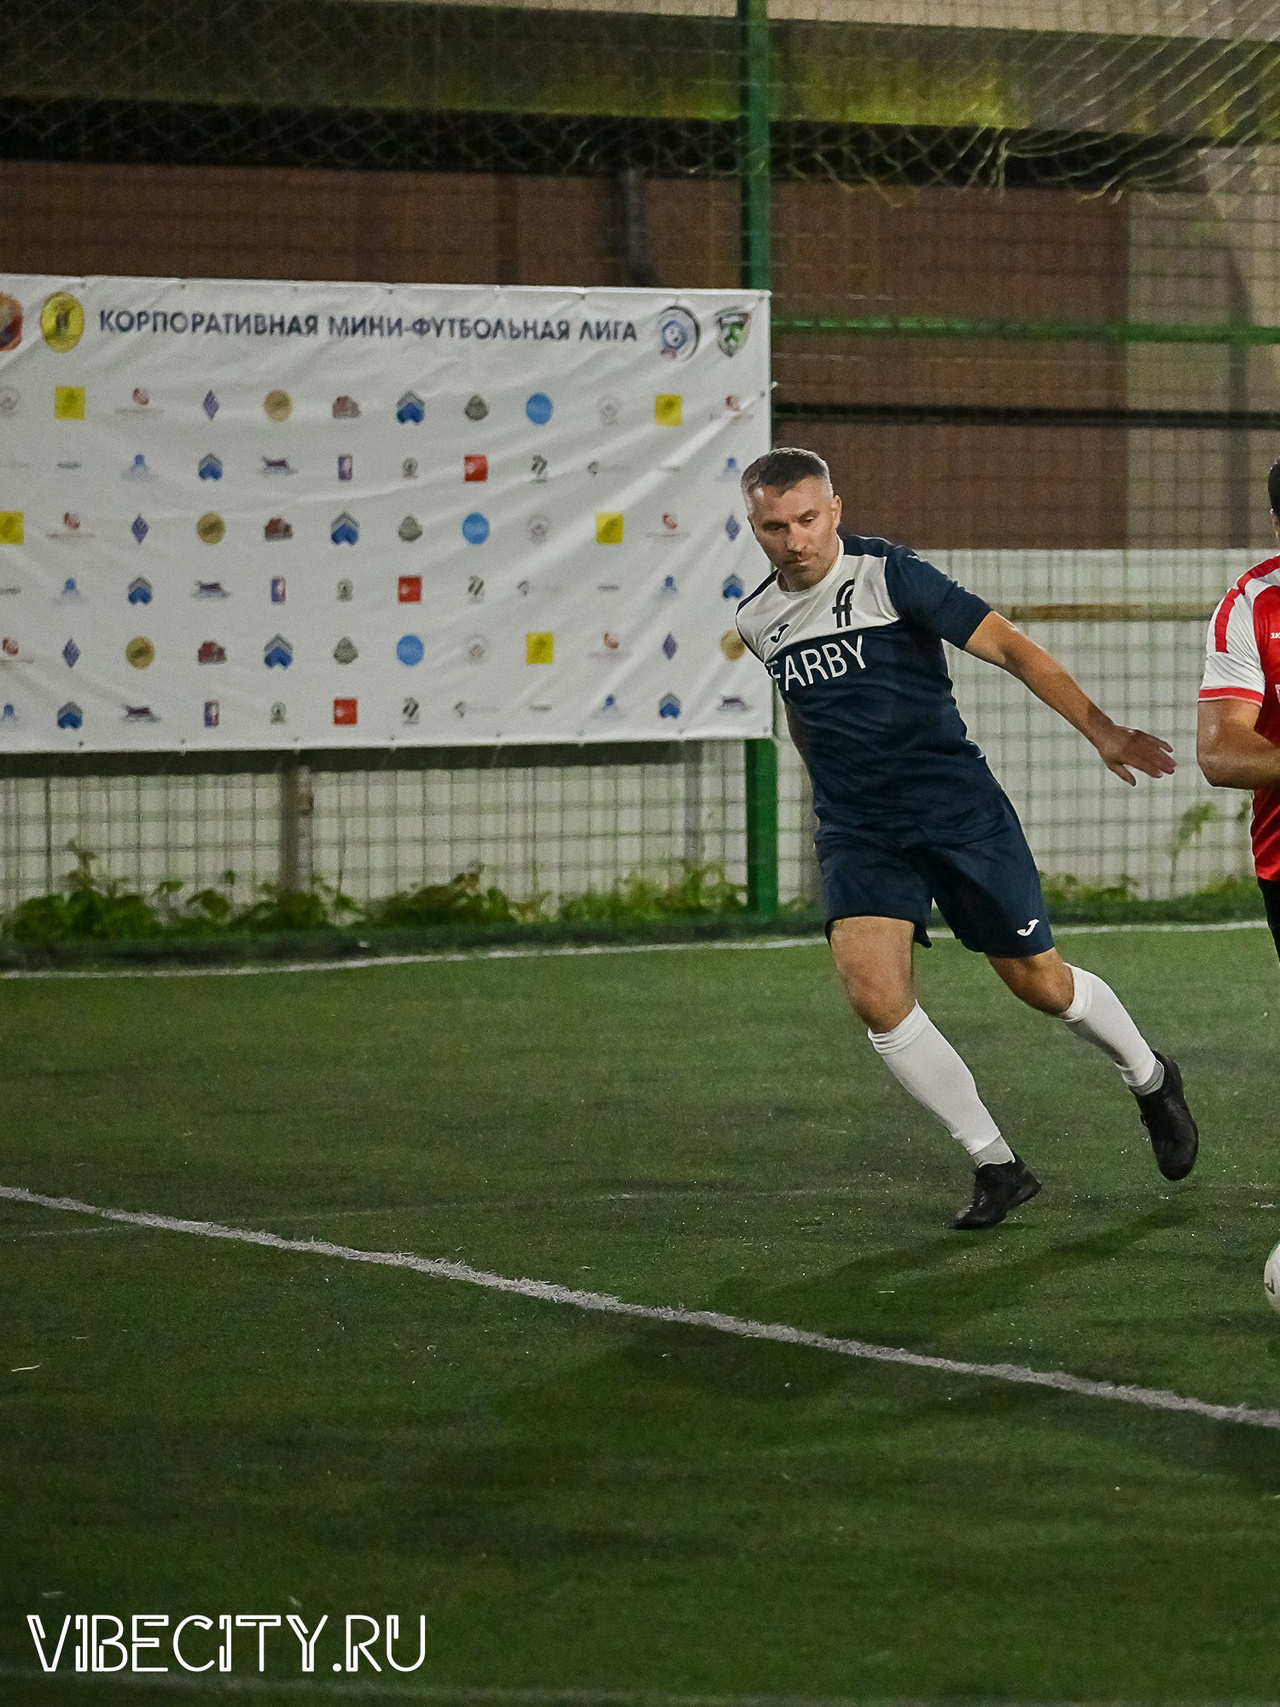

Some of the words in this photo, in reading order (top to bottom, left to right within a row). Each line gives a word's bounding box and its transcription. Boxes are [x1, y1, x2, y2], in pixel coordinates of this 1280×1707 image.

[99, 309, 319, 337] КОРПОРАТИВНАЯ
[328, 315, 571, 341] МИНИ-ФУТБОЛЬНАЯ
[579, 320, 638, 342] ЛИГА
